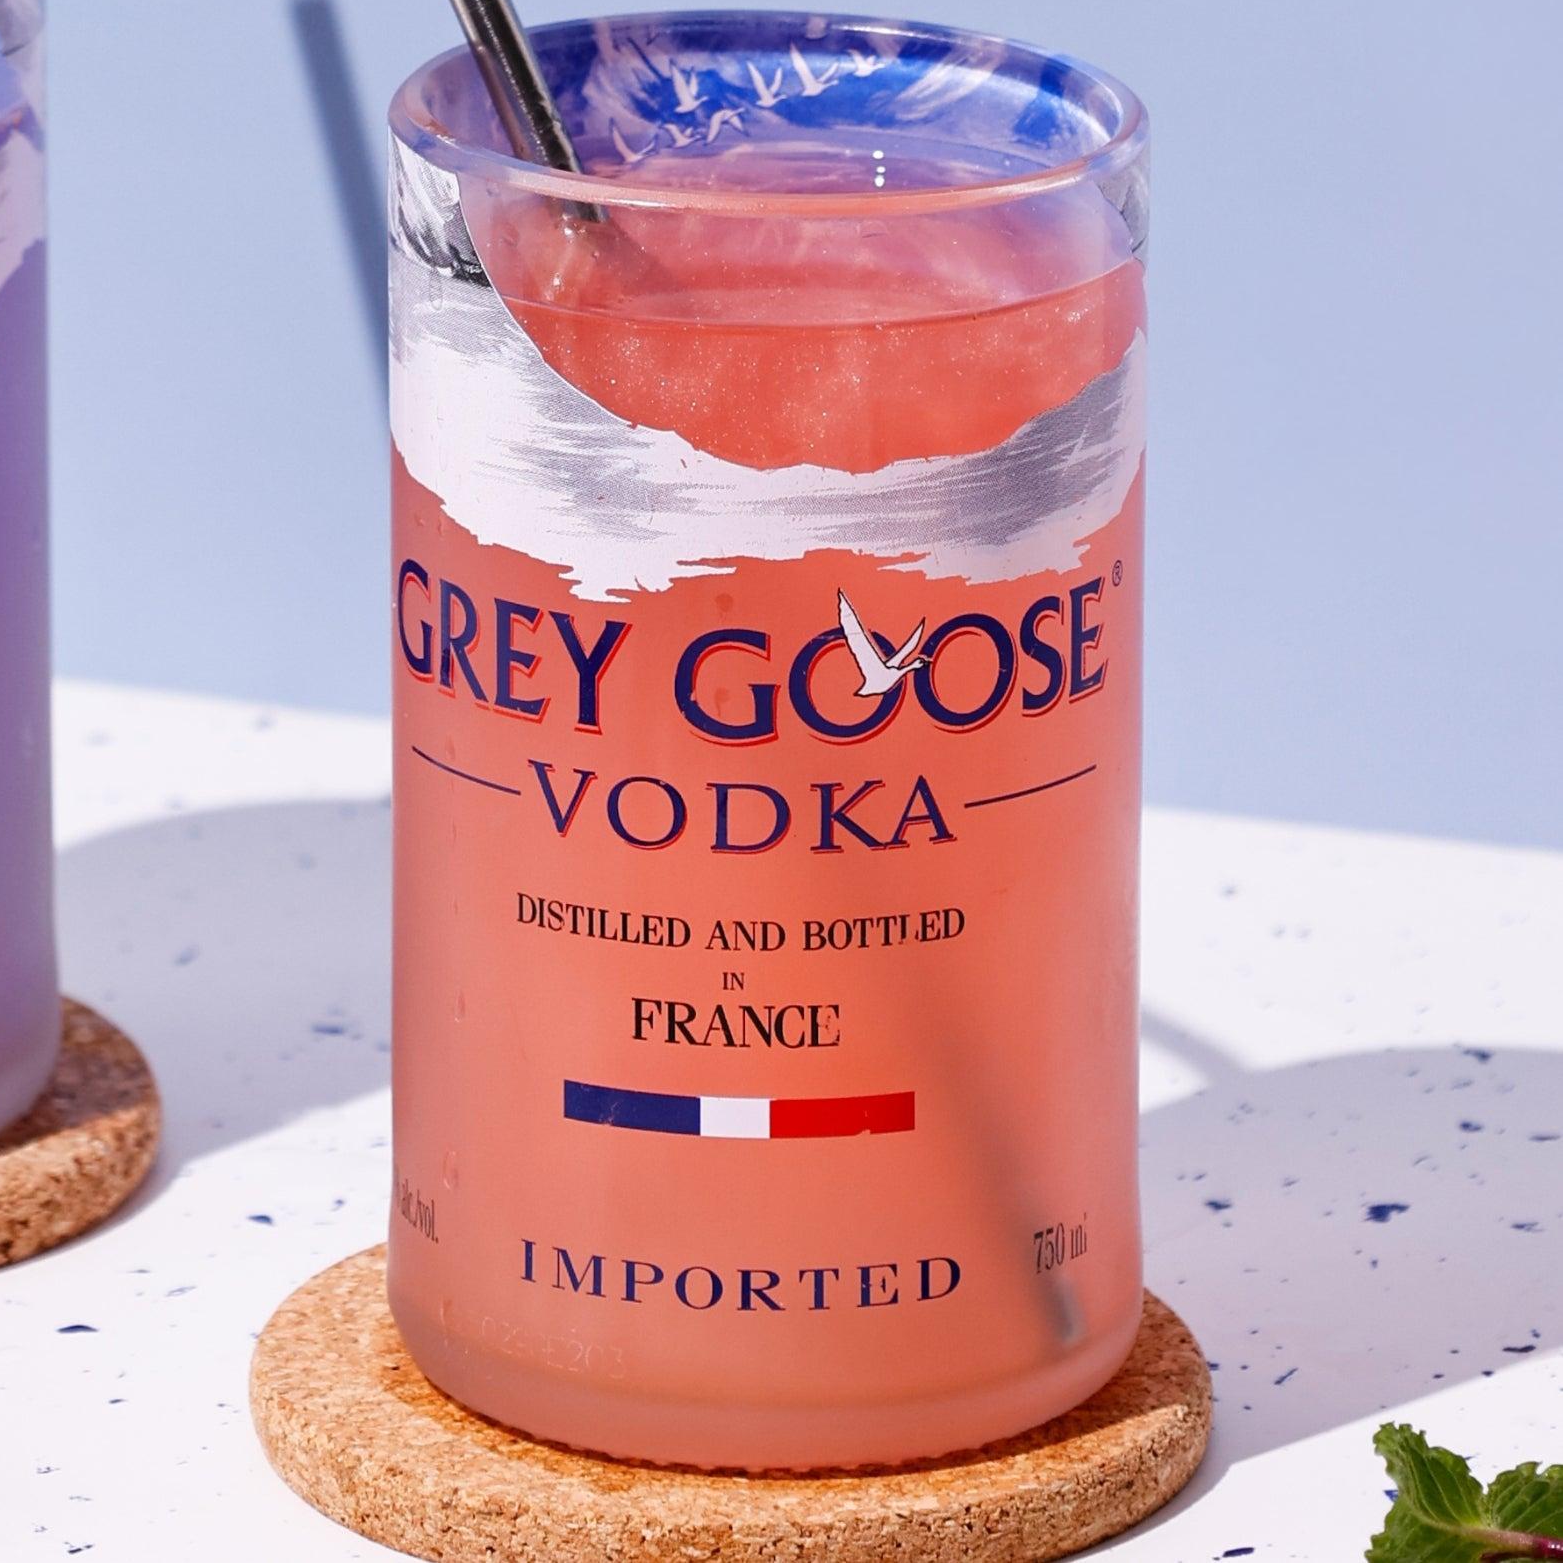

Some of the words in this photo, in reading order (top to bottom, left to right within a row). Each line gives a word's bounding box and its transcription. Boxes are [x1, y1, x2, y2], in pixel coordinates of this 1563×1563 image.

[396, 557, 633, 737] GREY
[527, 758, 958, 855] VODKA
[516, 892, 692, 950] DISTILLED
[705, 920, 787, 952] AND
[803, 907, 966, 952] BOTTLED
[722, 972, 746, 991] IN
[631, 998, 841, 1050] FRANCE
[519, 1238, 963, 1312] IMPORTED
[1033, 1222, 1065, 1275] 750
